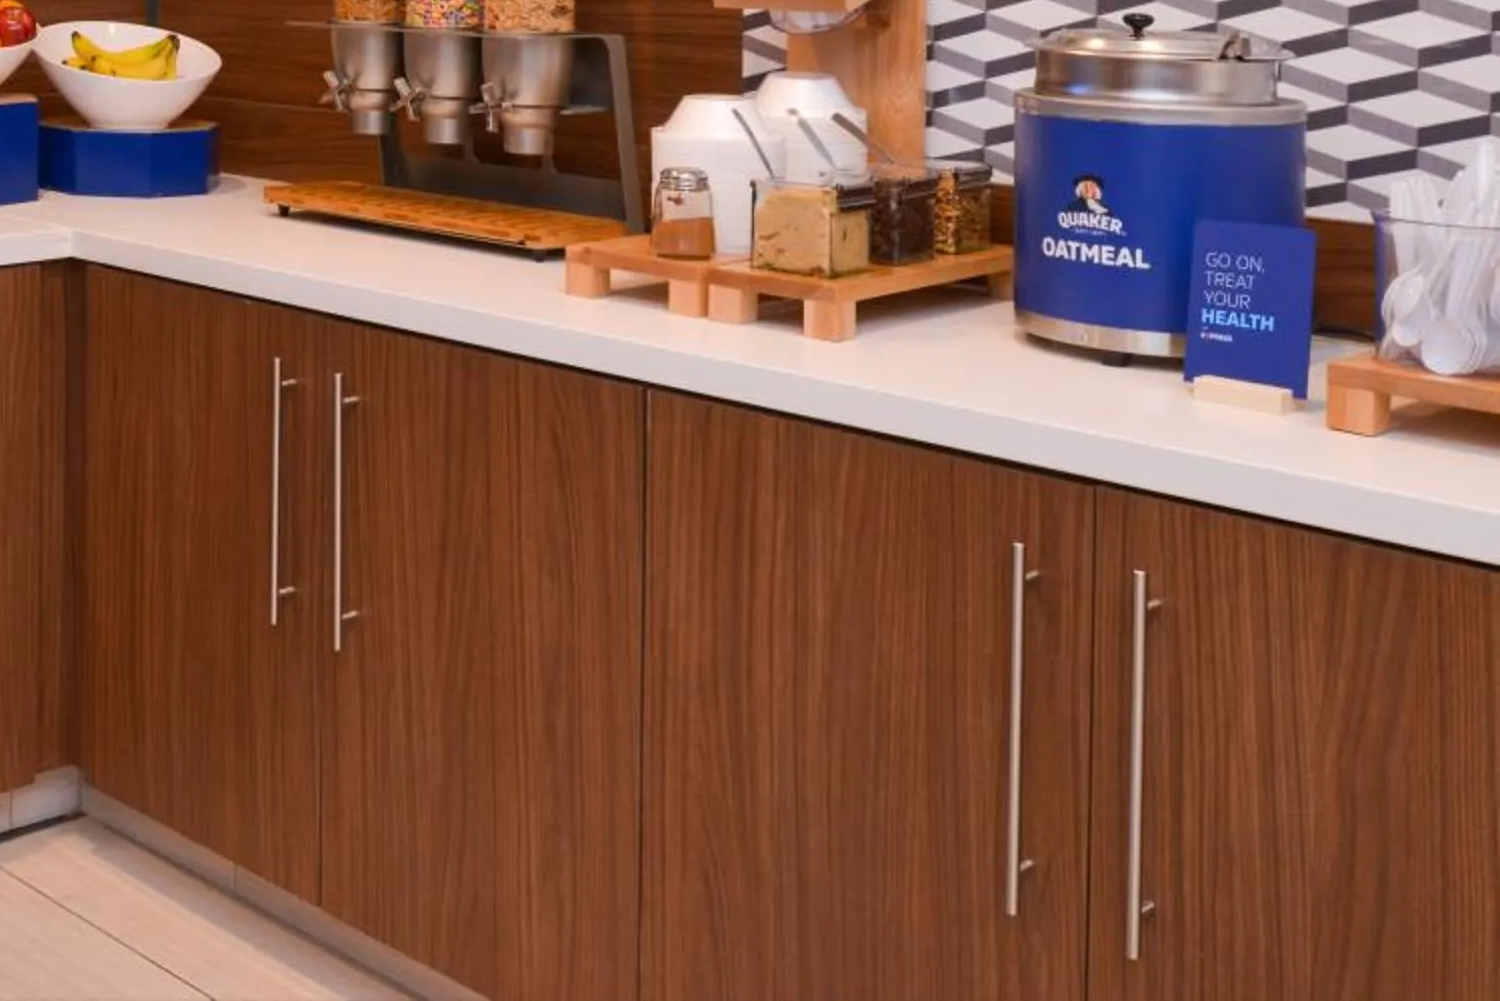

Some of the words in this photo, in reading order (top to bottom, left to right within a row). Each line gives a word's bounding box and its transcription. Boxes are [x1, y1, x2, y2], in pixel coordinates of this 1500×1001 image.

[1057, 212, 1123, 233] QUAKER
[1042, 236, 1152, 269] OATMEAL
[1205, 252, 1231, 268] GO
[1204, 270, 1256, 290] TREAT
[1204, 290, 1252, 309] YOUR
[1201, 308, 1275, 332] HEALTH
